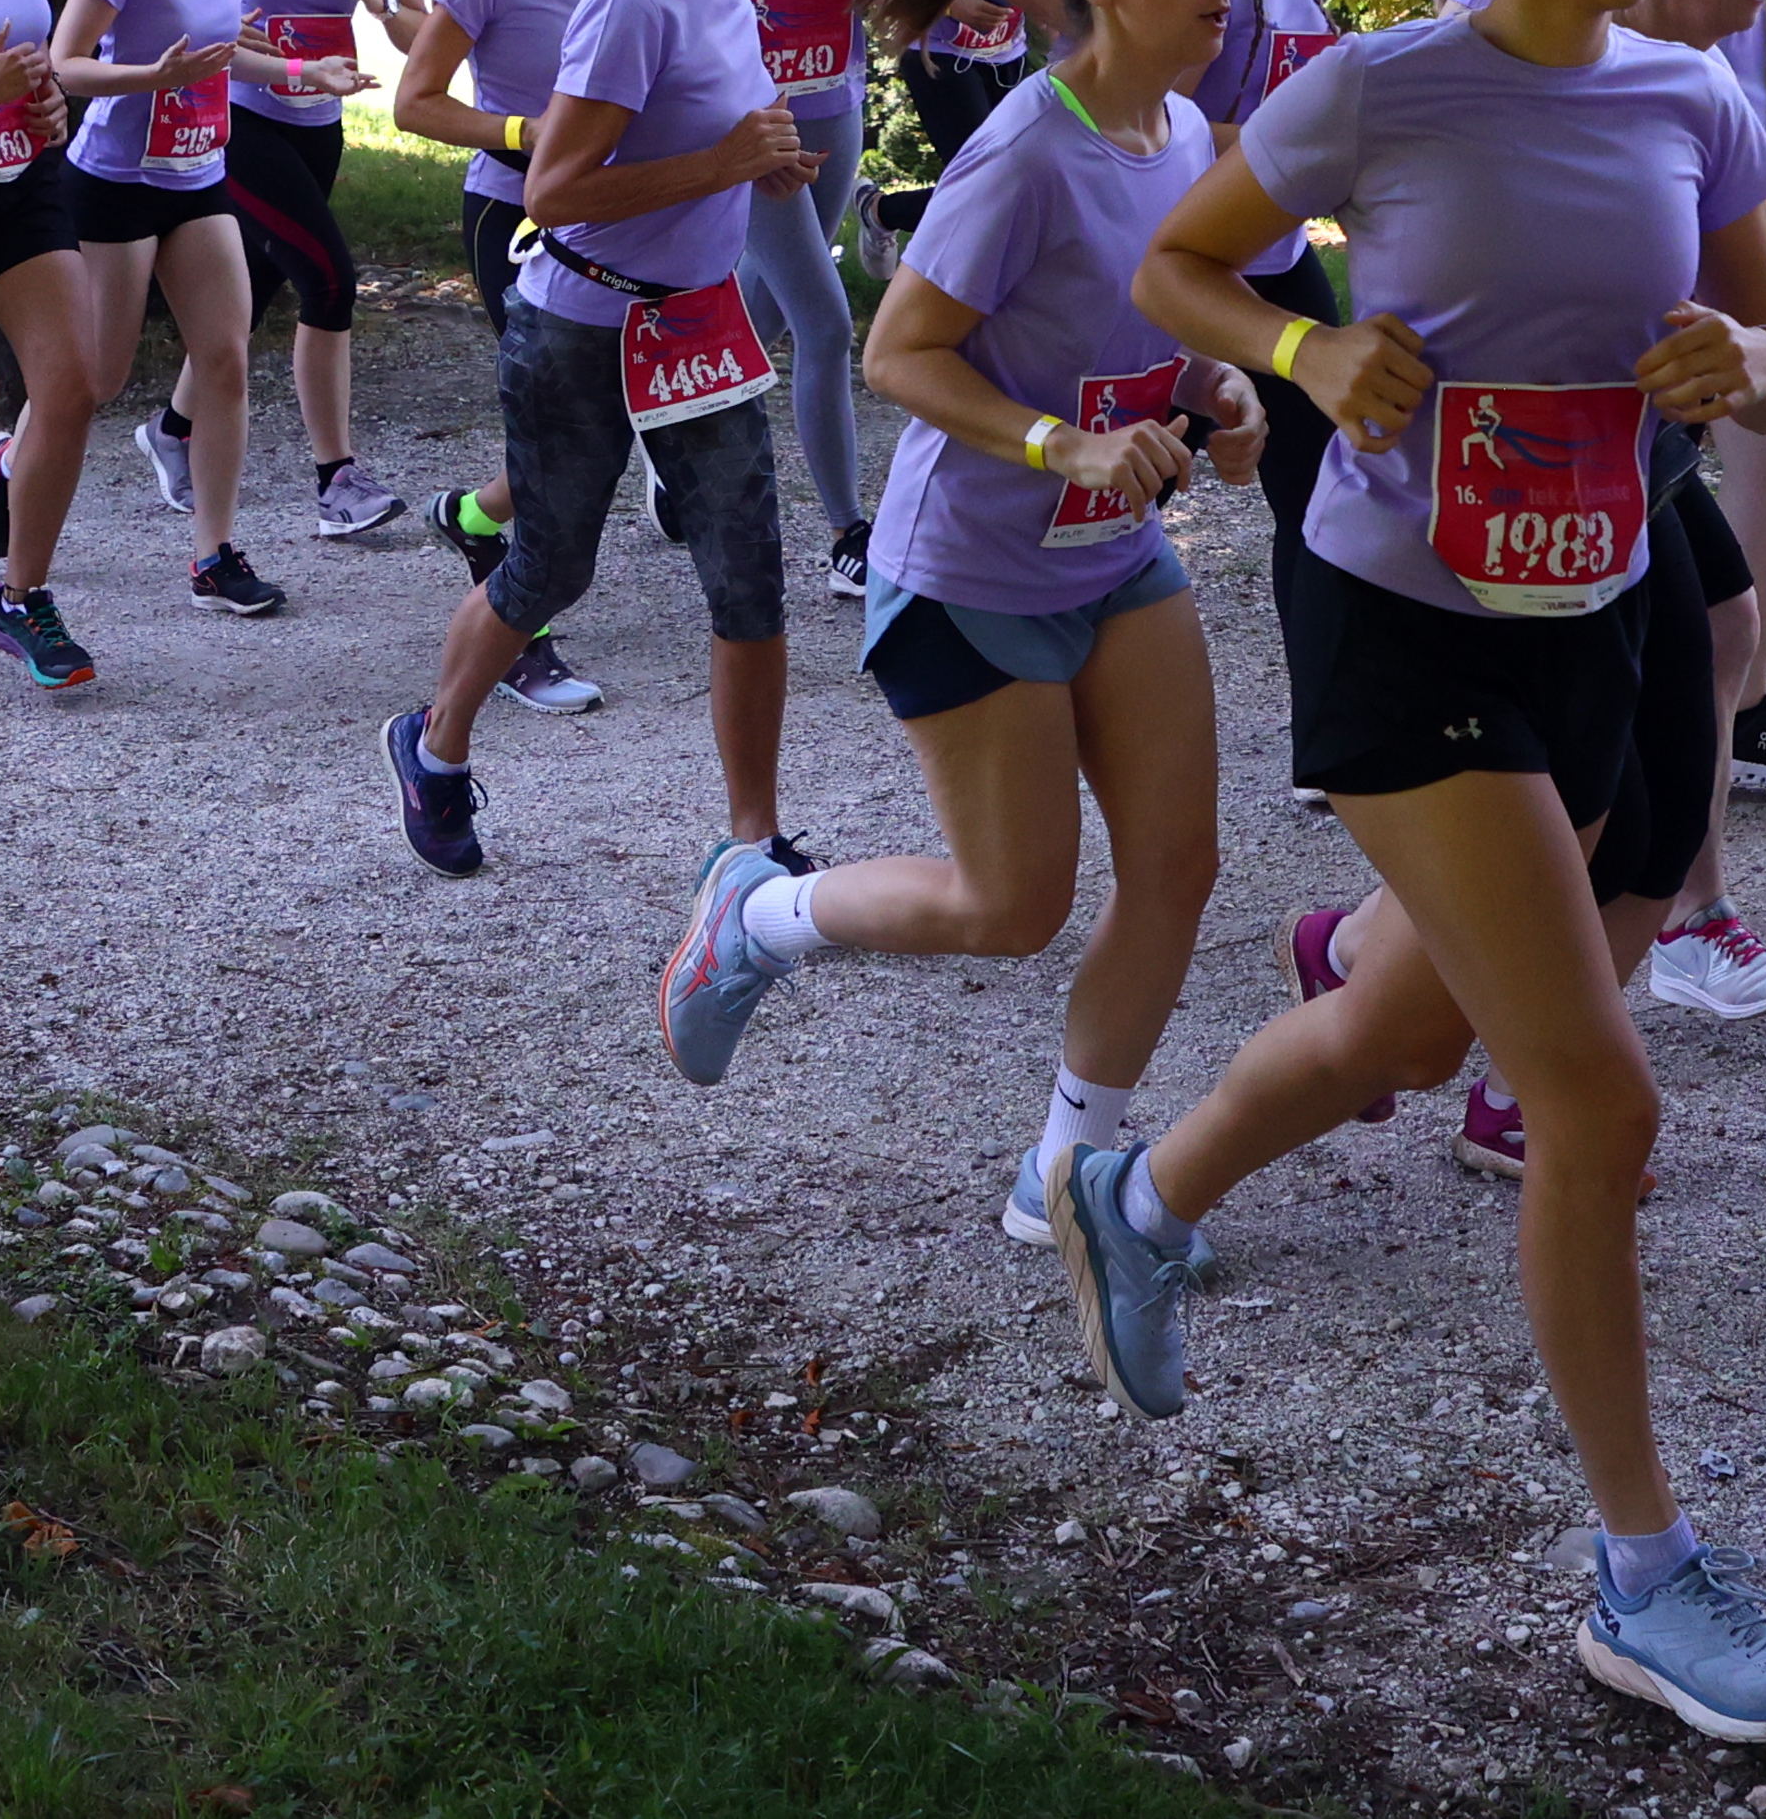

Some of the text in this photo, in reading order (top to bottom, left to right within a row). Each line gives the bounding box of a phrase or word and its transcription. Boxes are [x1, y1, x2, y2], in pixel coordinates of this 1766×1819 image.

[763, 44, 834, 80] 3740
[601, 270, 641, 292] triglav
[648, 348, 744, 402] 4464
[1454, 484, 1483, 506] 16.
[1483, 510, 1614, 580] 1983
